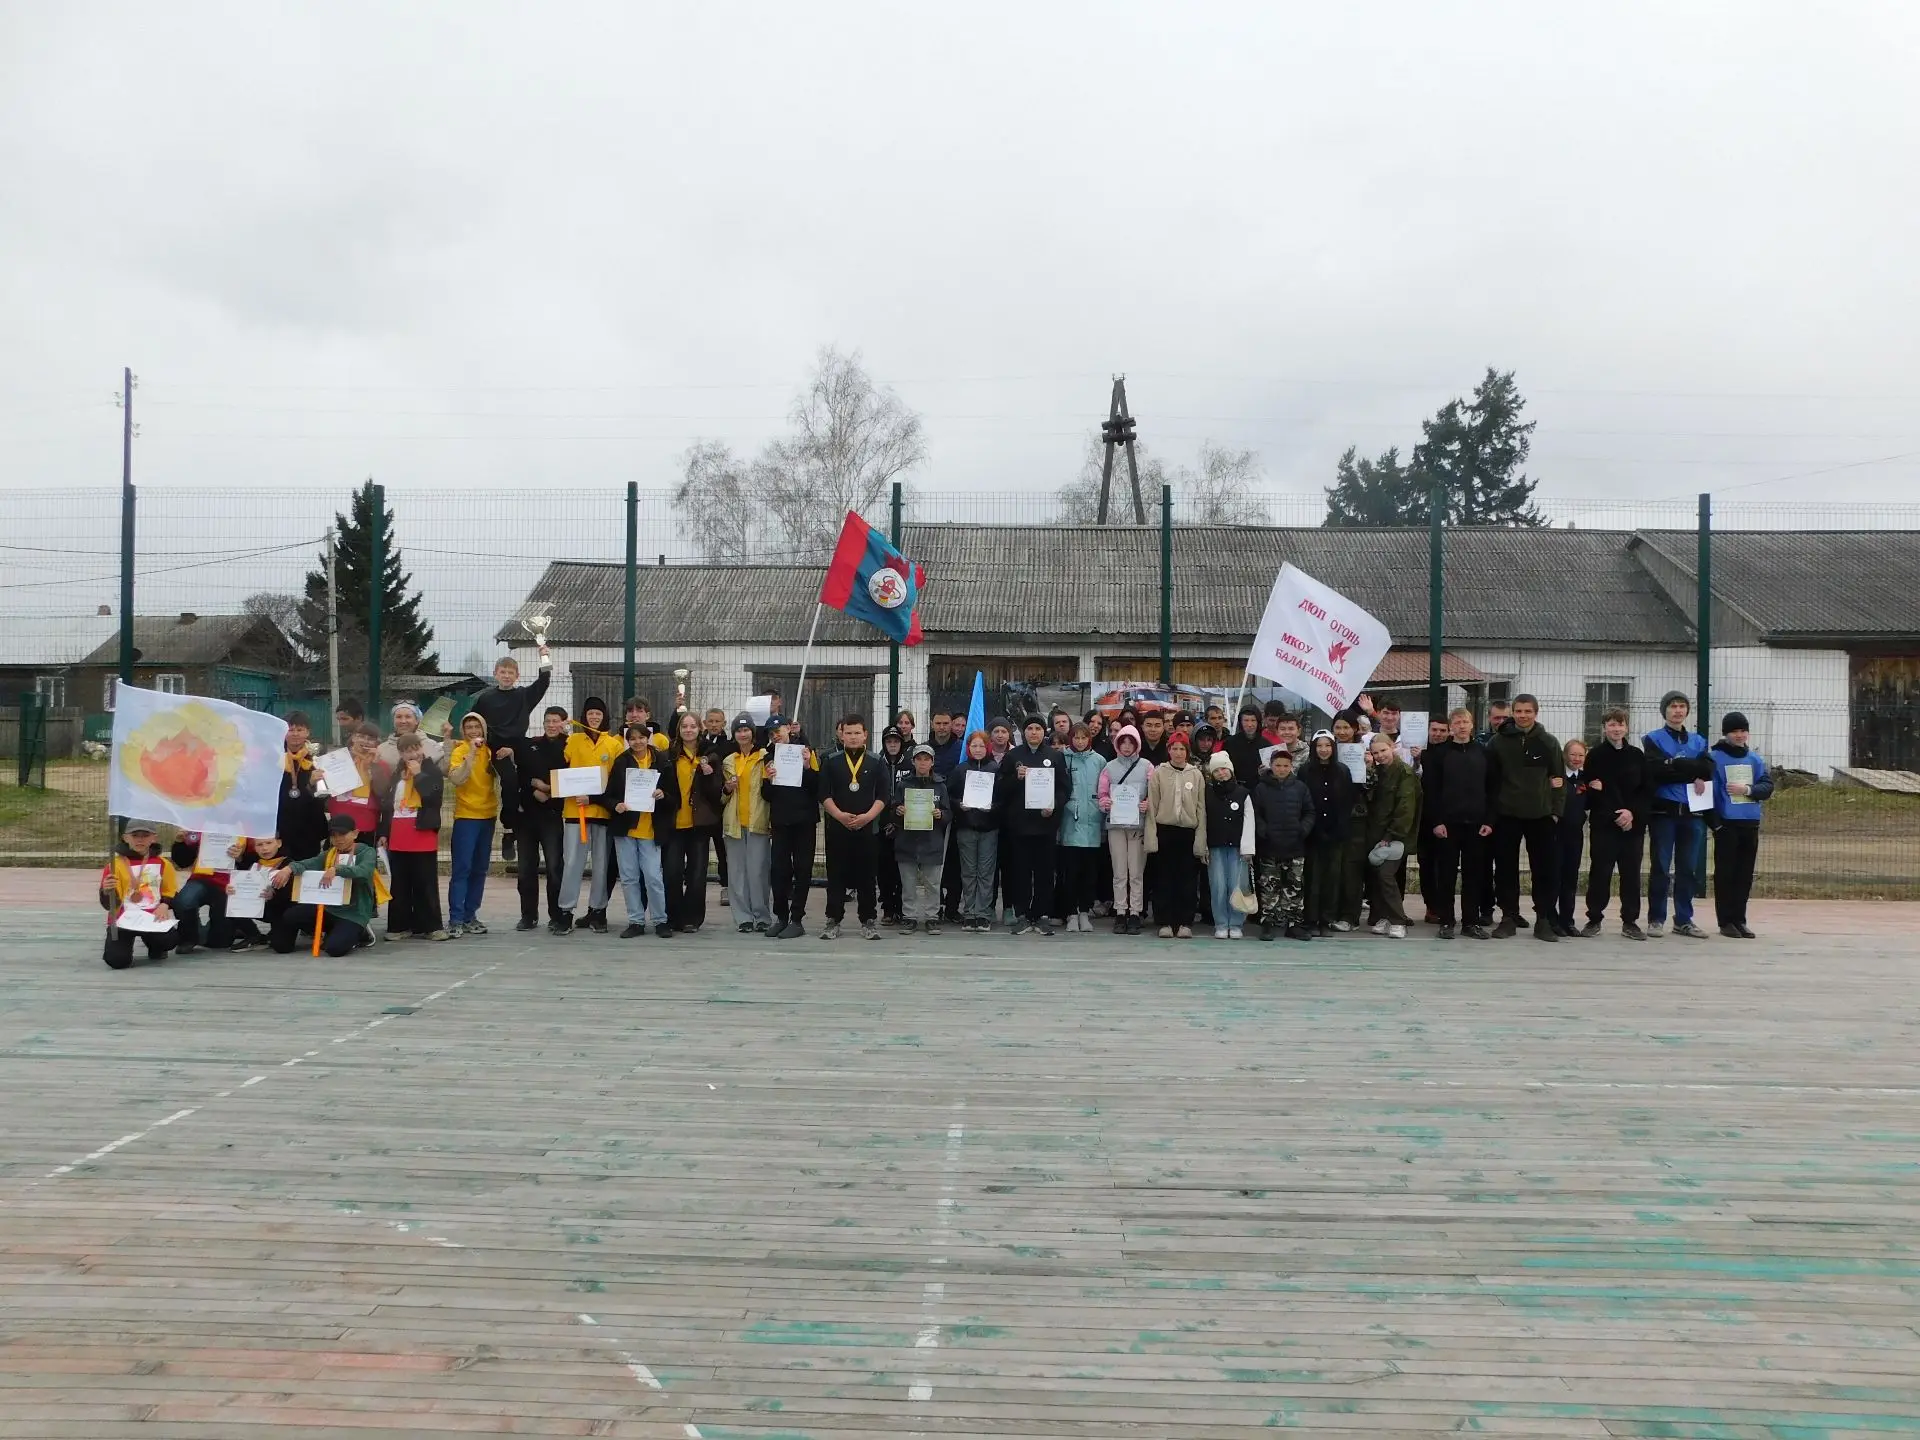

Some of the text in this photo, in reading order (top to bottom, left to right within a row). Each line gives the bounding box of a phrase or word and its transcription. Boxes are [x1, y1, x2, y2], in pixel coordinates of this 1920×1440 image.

[1298, 599, 1360, 646] ДЮП ОГОНЬ
[1281, 632, 1314, 654] МКОУ
[1326, 692, 1344, 711] ООШ
